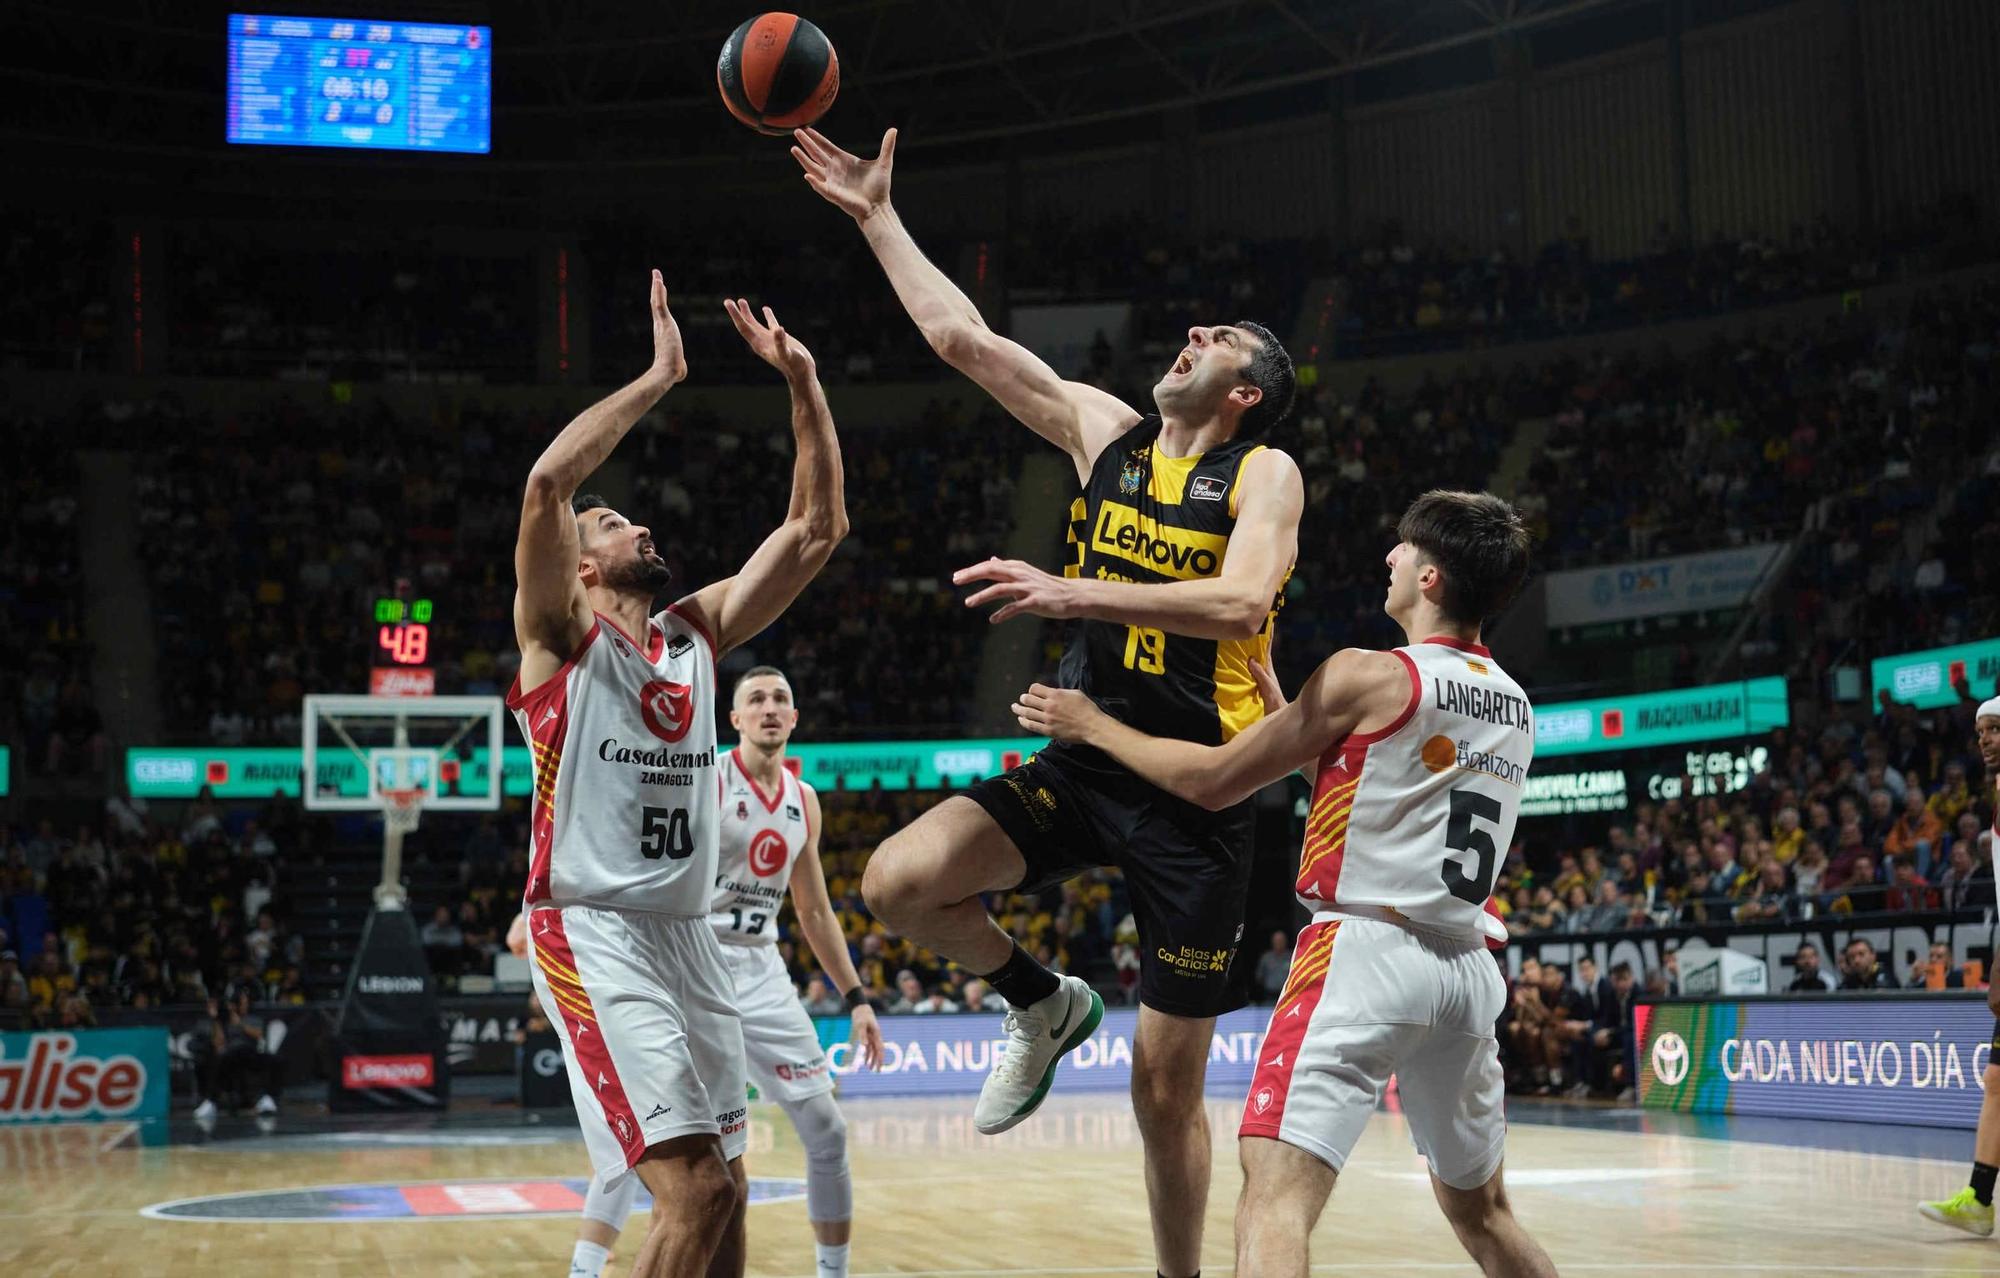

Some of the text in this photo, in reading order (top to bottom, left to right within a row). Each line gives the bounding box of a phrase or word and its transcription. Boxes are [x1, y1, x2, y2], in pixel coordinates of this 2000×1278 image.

[1193, 489, 1221, 498] endesa
[1098, 510, 1217, 576] Lenovo
[1123, 623, 1166, 677] 19
[1434, 677, 1530, 734] LANGARITA
[598, 738, 717, 769] Casademnt
[640, 771, 694, 787] ZARAGOZA
[640, 806, 695, 860] 50
[1440, 788, 1502, 906] 5
[1157, 947, 1209, 972] Canarias
[1180, 944, 1210, 961] Islas
[358, 975, 425, 993] LEGION
[350, 1063, 428, 1081] Lenovo
[1721, 1038, 1796, 1083] CADA
[1801, 1039, 1902, 1088] NUEVO
[1911, 1029, 1966, 1090] DÍA
